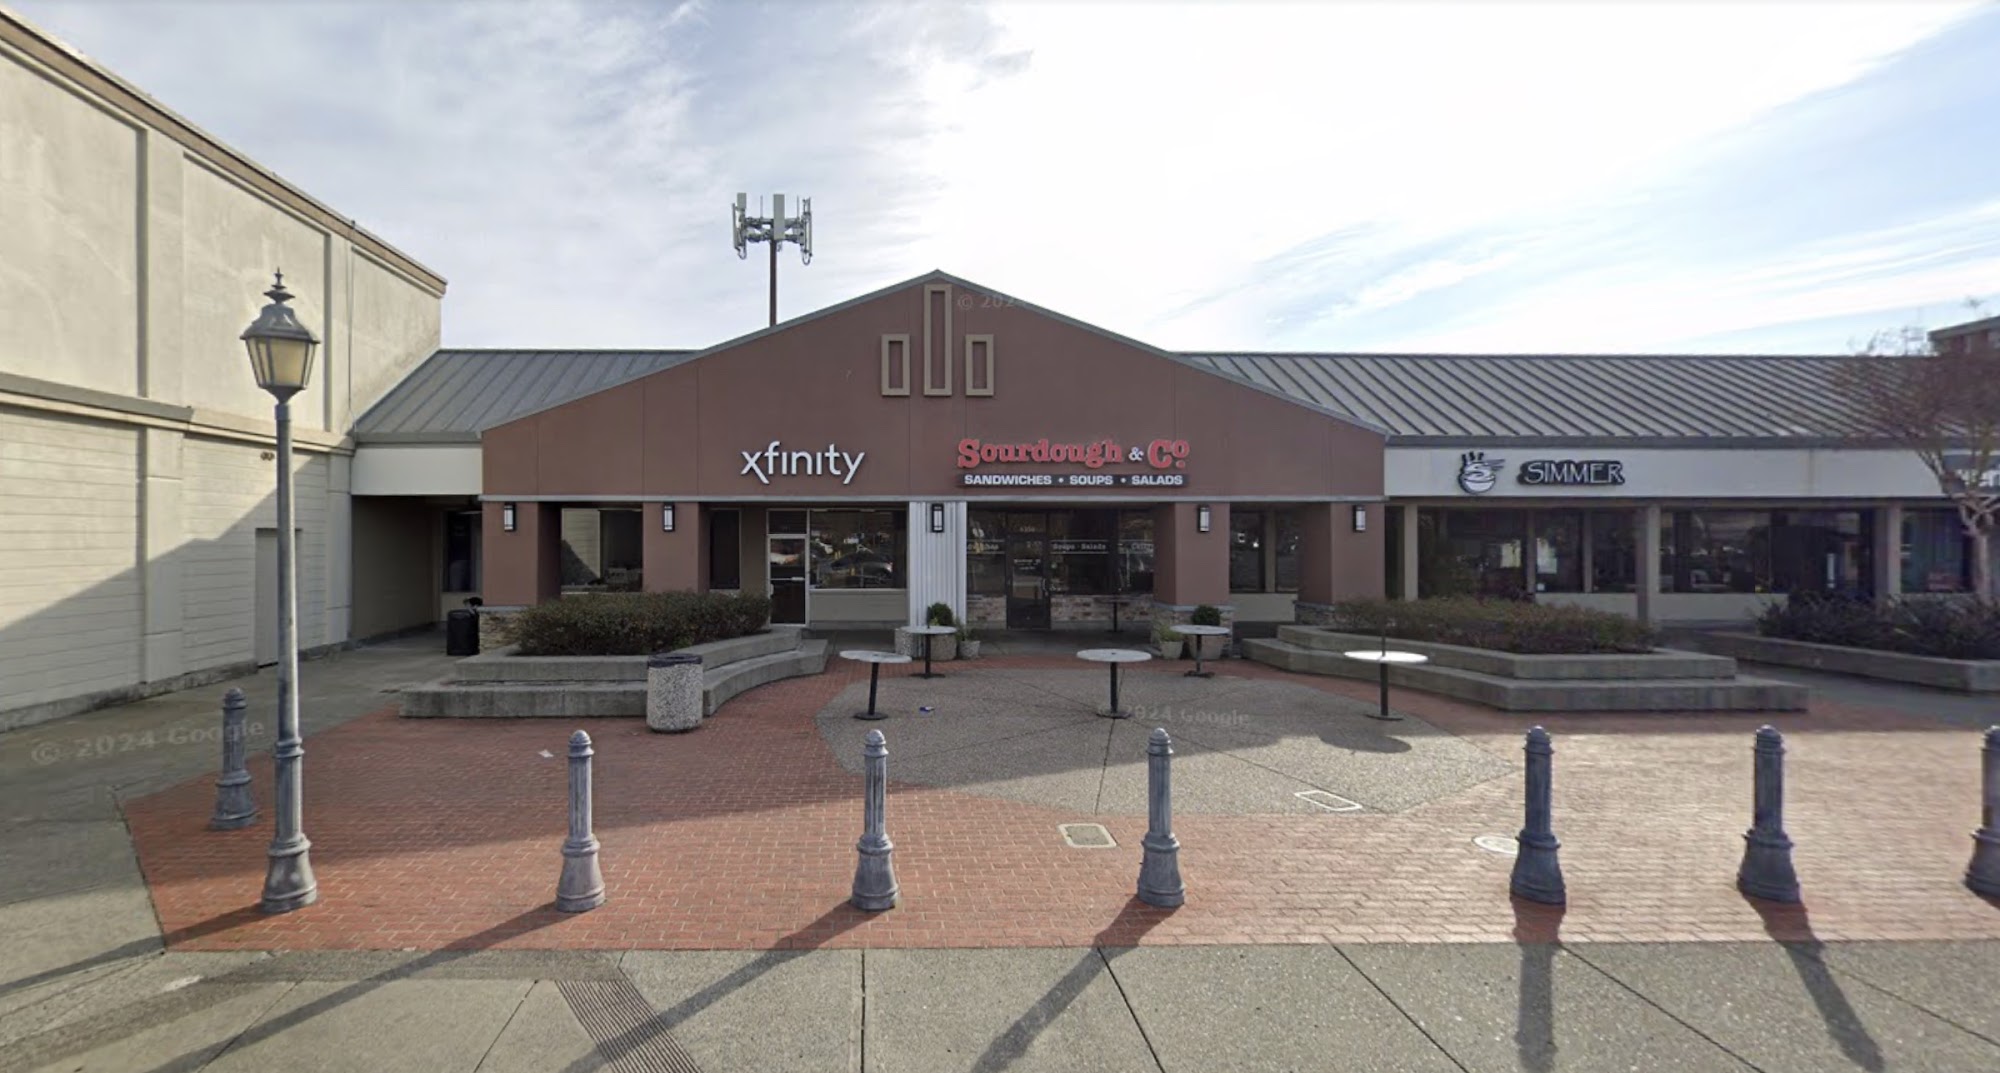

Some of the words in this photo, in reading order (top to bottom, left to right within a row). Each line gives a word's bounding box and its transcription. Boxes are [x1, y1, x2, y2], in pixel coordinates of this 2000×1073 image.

[740, 441, 866, 485] xfinity
[957, 438, 1124, 469] Sourdough
[1128, 446, 1145, 462] &
[963, 474, 1052, 486] SANDWICHES
[1069, 474, 1114, 486] SOUPS
[1131, 474, 1184, 486] SALADS
[1522, 461, 1625, 485] SIMMER
